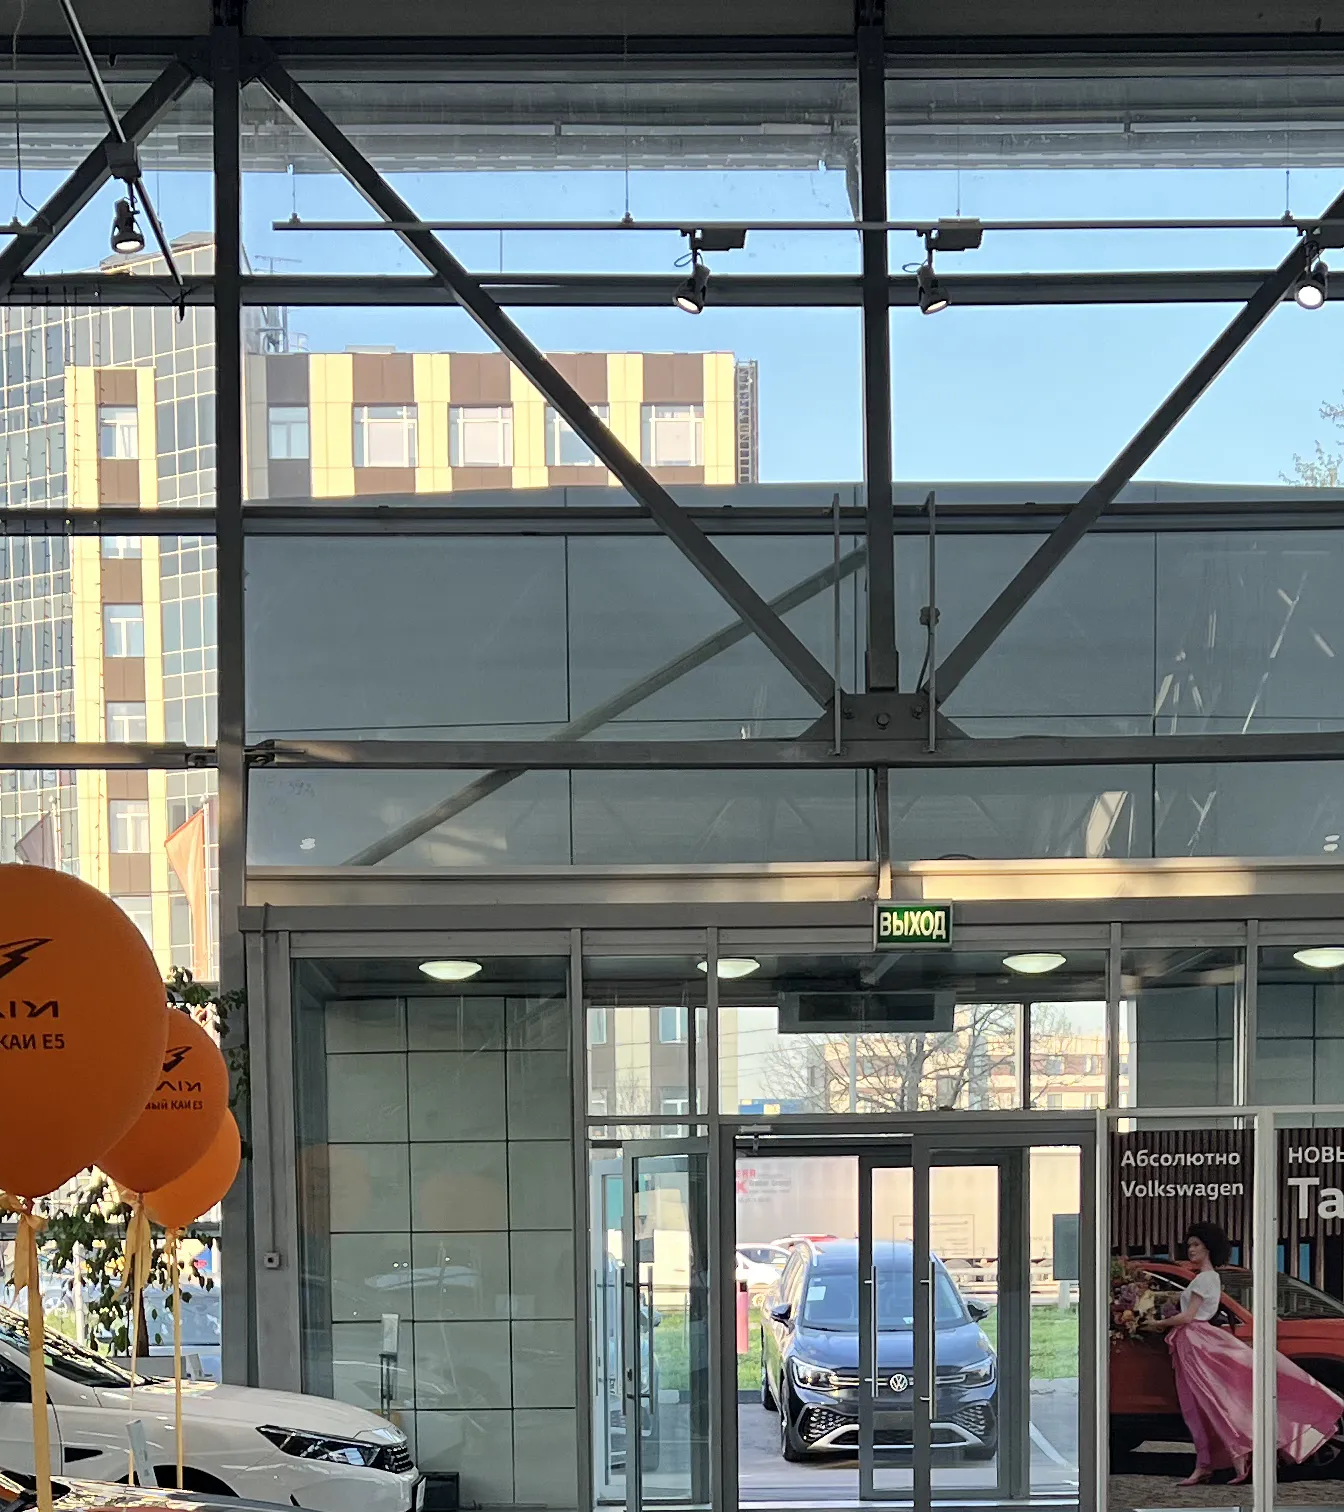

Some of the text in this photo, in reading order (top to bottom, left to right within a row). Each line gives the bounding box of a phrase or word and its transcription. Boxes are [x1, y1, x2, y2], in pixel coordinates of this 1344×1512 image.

[879, 910, 947, 940] ВЫХОД
[41, 1033, 65, 1050] E5
[1120, 1149, 1241, 1167] Абсолютно
[1120, 1179, 1244, 1200] Volkswagen
